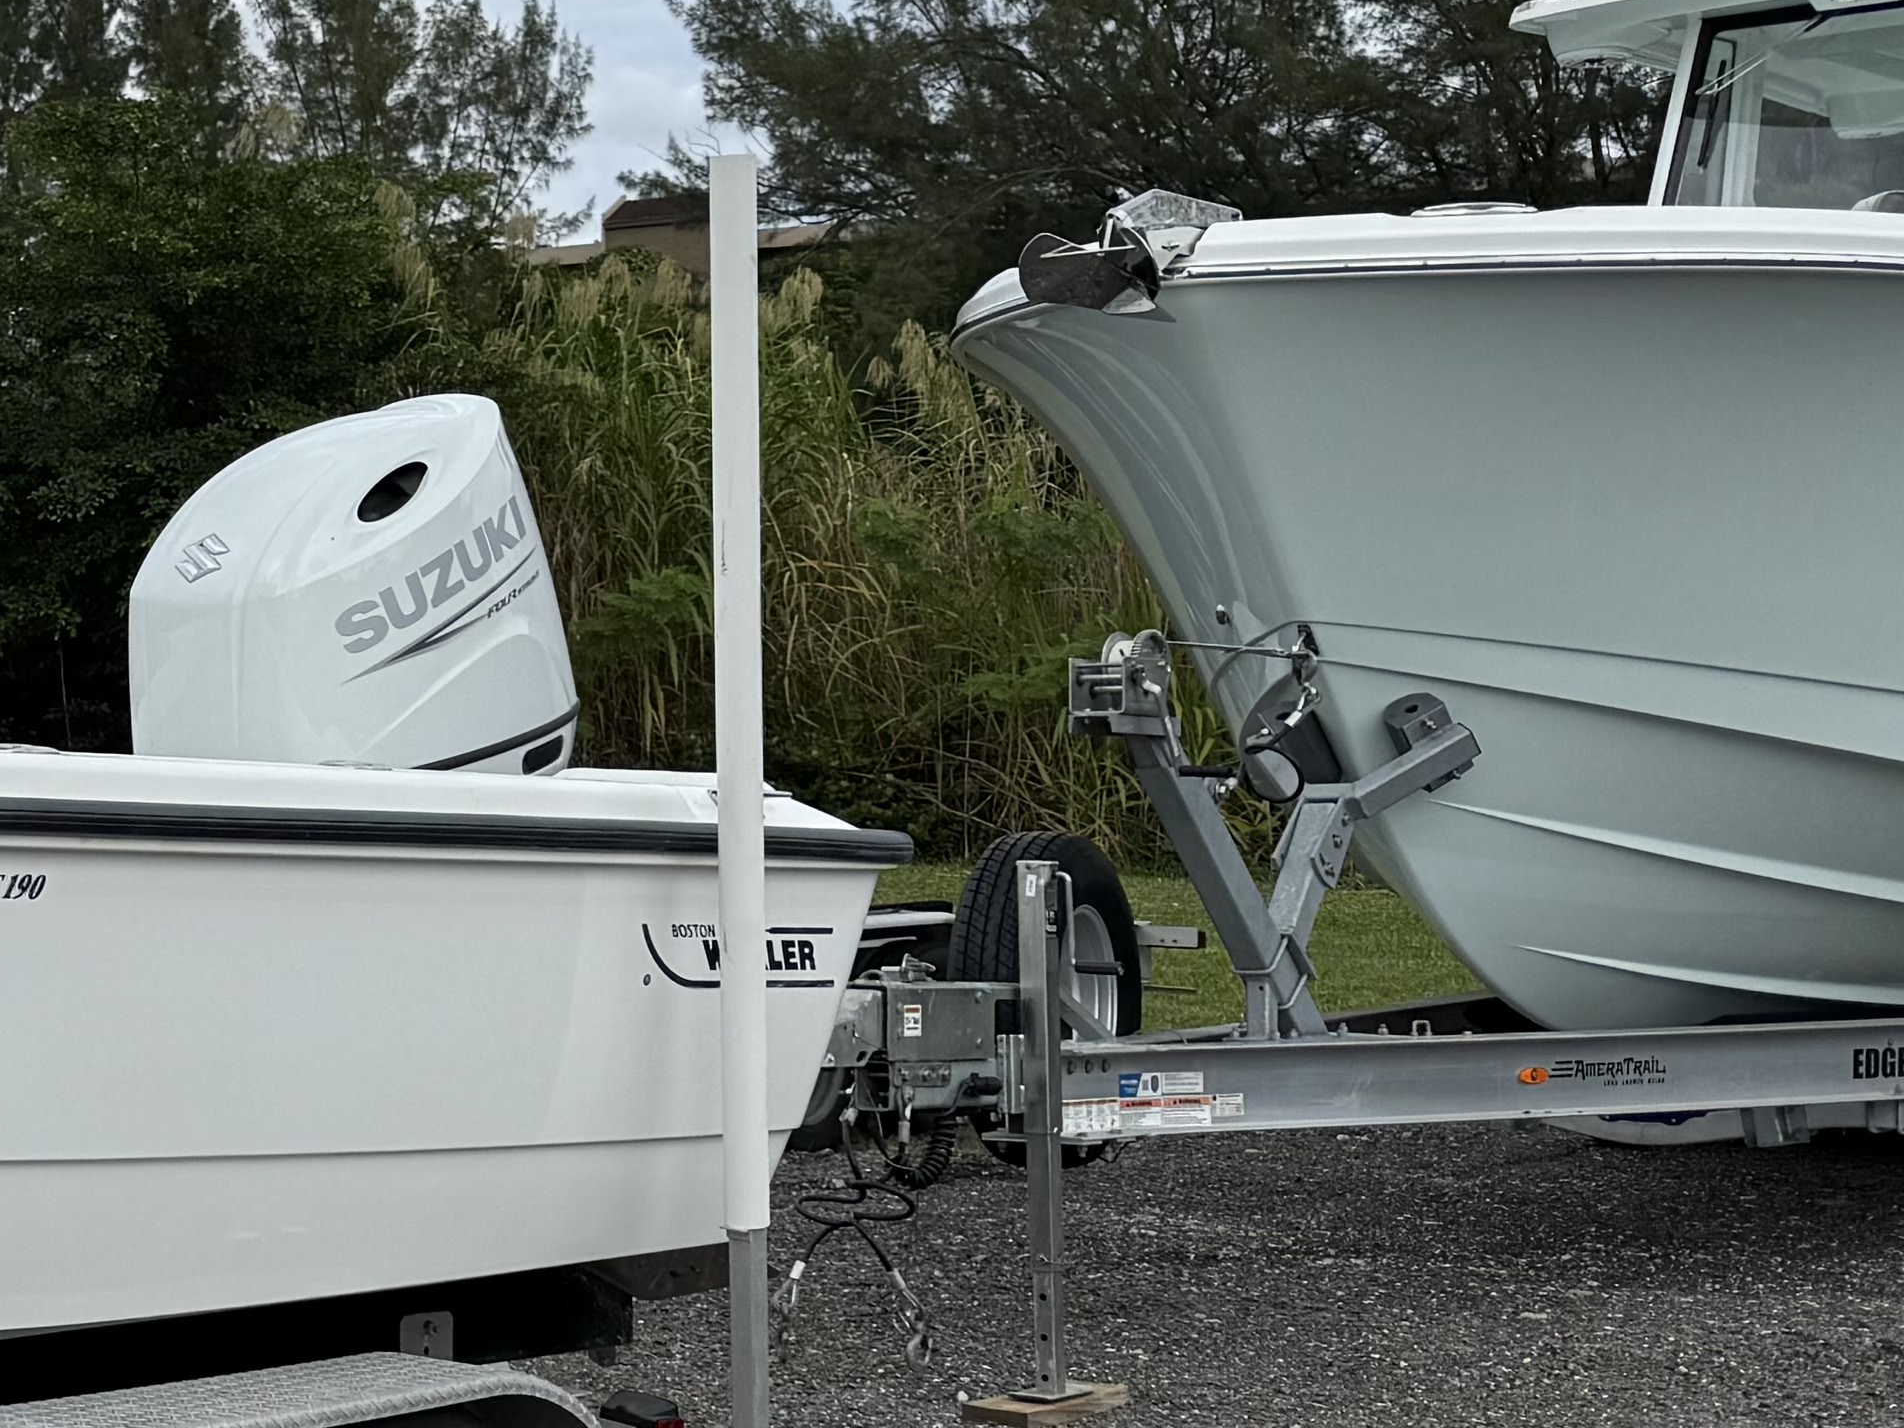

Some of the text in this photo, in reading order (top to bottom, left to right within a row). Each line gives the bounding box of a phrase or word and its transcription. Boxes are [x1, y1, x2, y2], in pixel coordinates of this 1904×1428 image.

[334, 495, 527, 654] SUZUKI
[1, 874, 47, 900] 190
[671, 923, 716, 939] BOSTON
[702, 939, 816, 971] WLER
